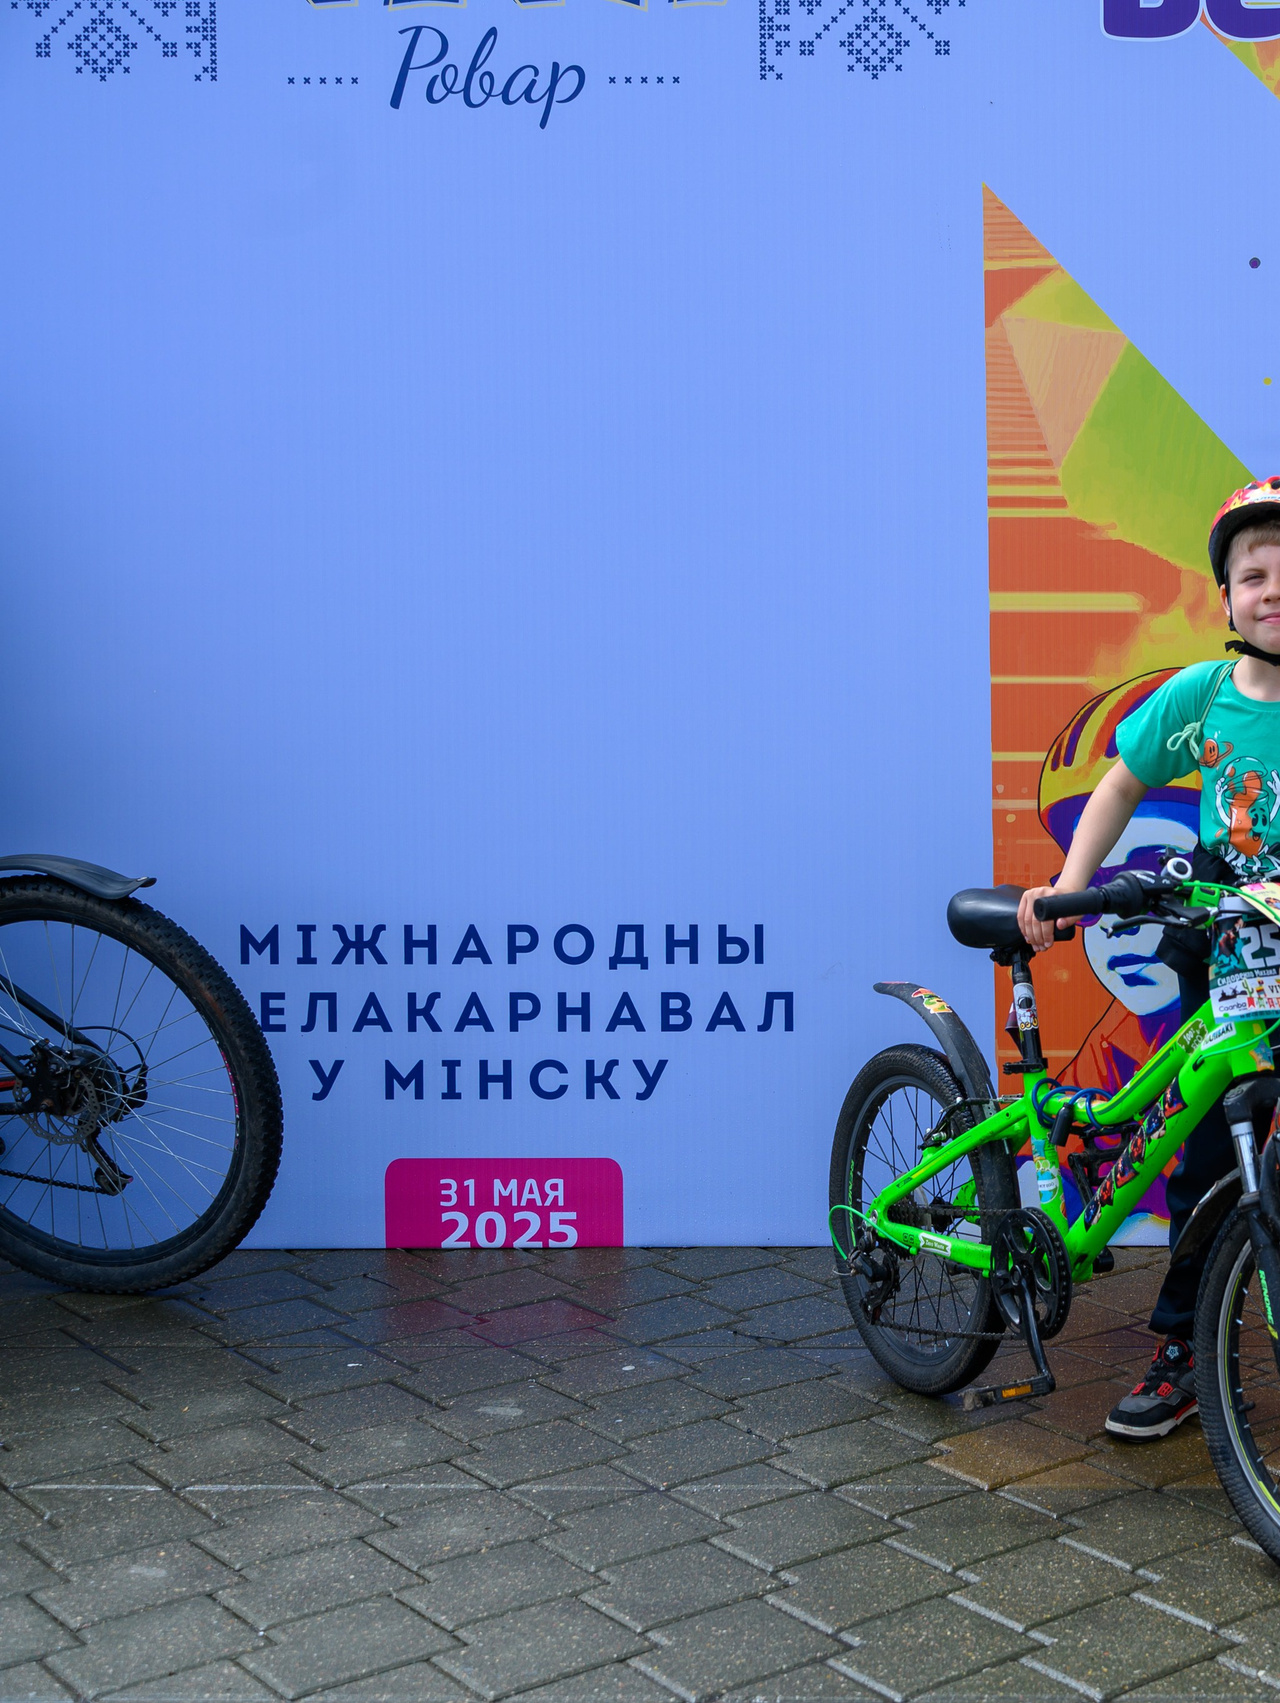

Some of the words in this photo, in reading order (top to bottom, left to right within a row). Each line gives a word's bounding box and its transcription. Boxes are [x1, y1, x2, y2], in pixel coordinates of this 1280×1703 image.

[389, 25, 586, 130] Ровар
[240, 924, 765, 970] МІЖНАРОДНЫ
[260, 991, 795, 1033] ЕЛАКАРНАВАЛ
[309, 1059, 345, 1101] У
[384, 1059, 669, 1101] МІНСКУ
[439, 1179, 476, 1207] 31
[492, 1178, 565, 1207] МАЯ
[440, 1211, 579, 1249] 2025
